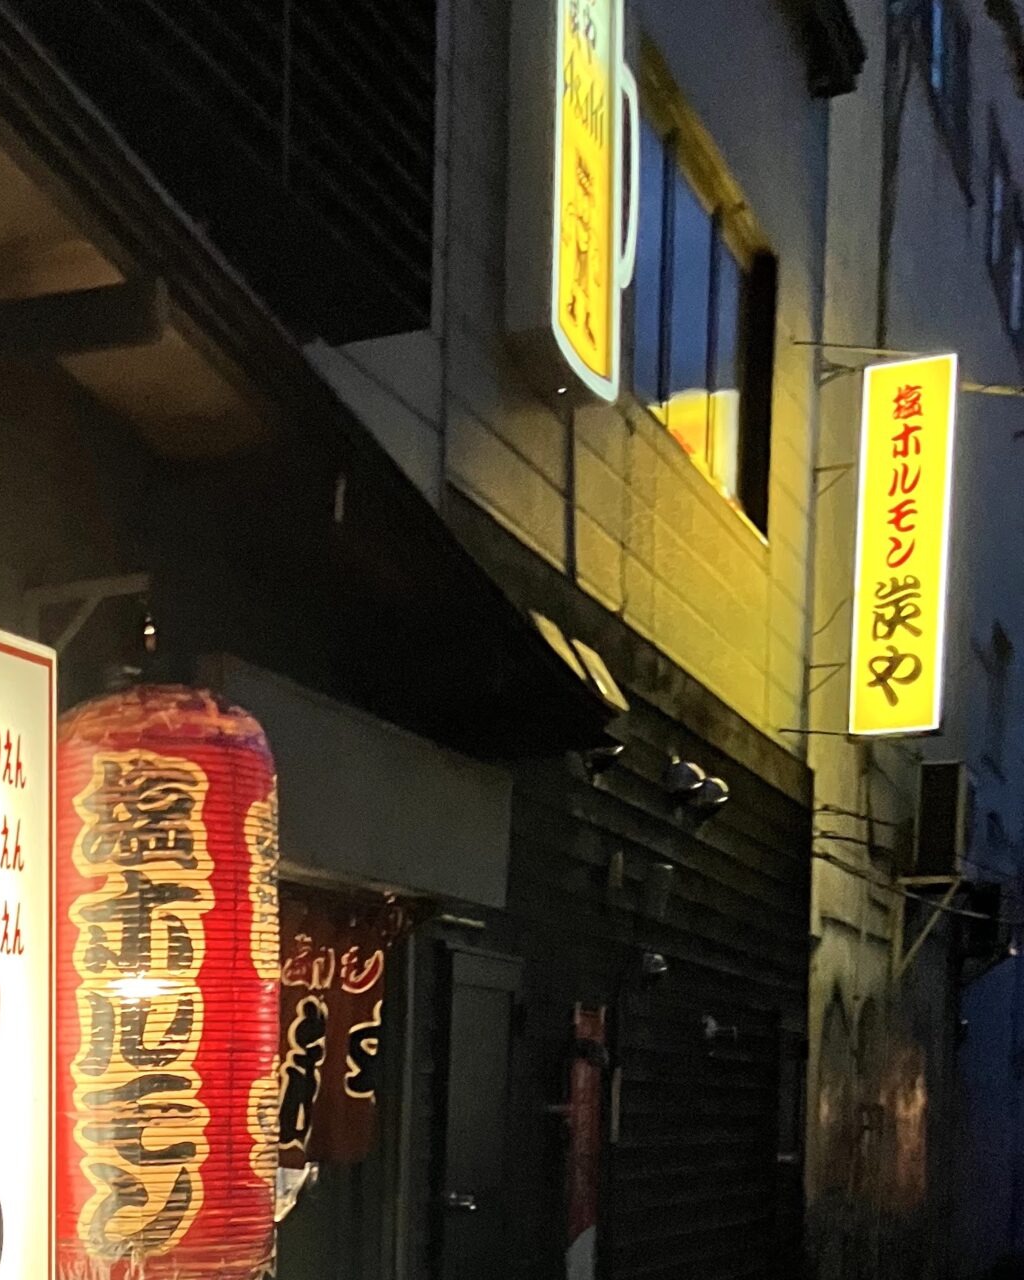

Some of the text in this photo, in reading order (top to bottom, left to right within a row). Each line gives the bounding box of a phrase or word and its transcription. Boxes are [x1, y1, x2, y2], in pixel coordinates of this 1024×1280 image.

[866, 384, 924, 706] 塩ホルモン 炭や
[0, 813, 25, 872] えん
